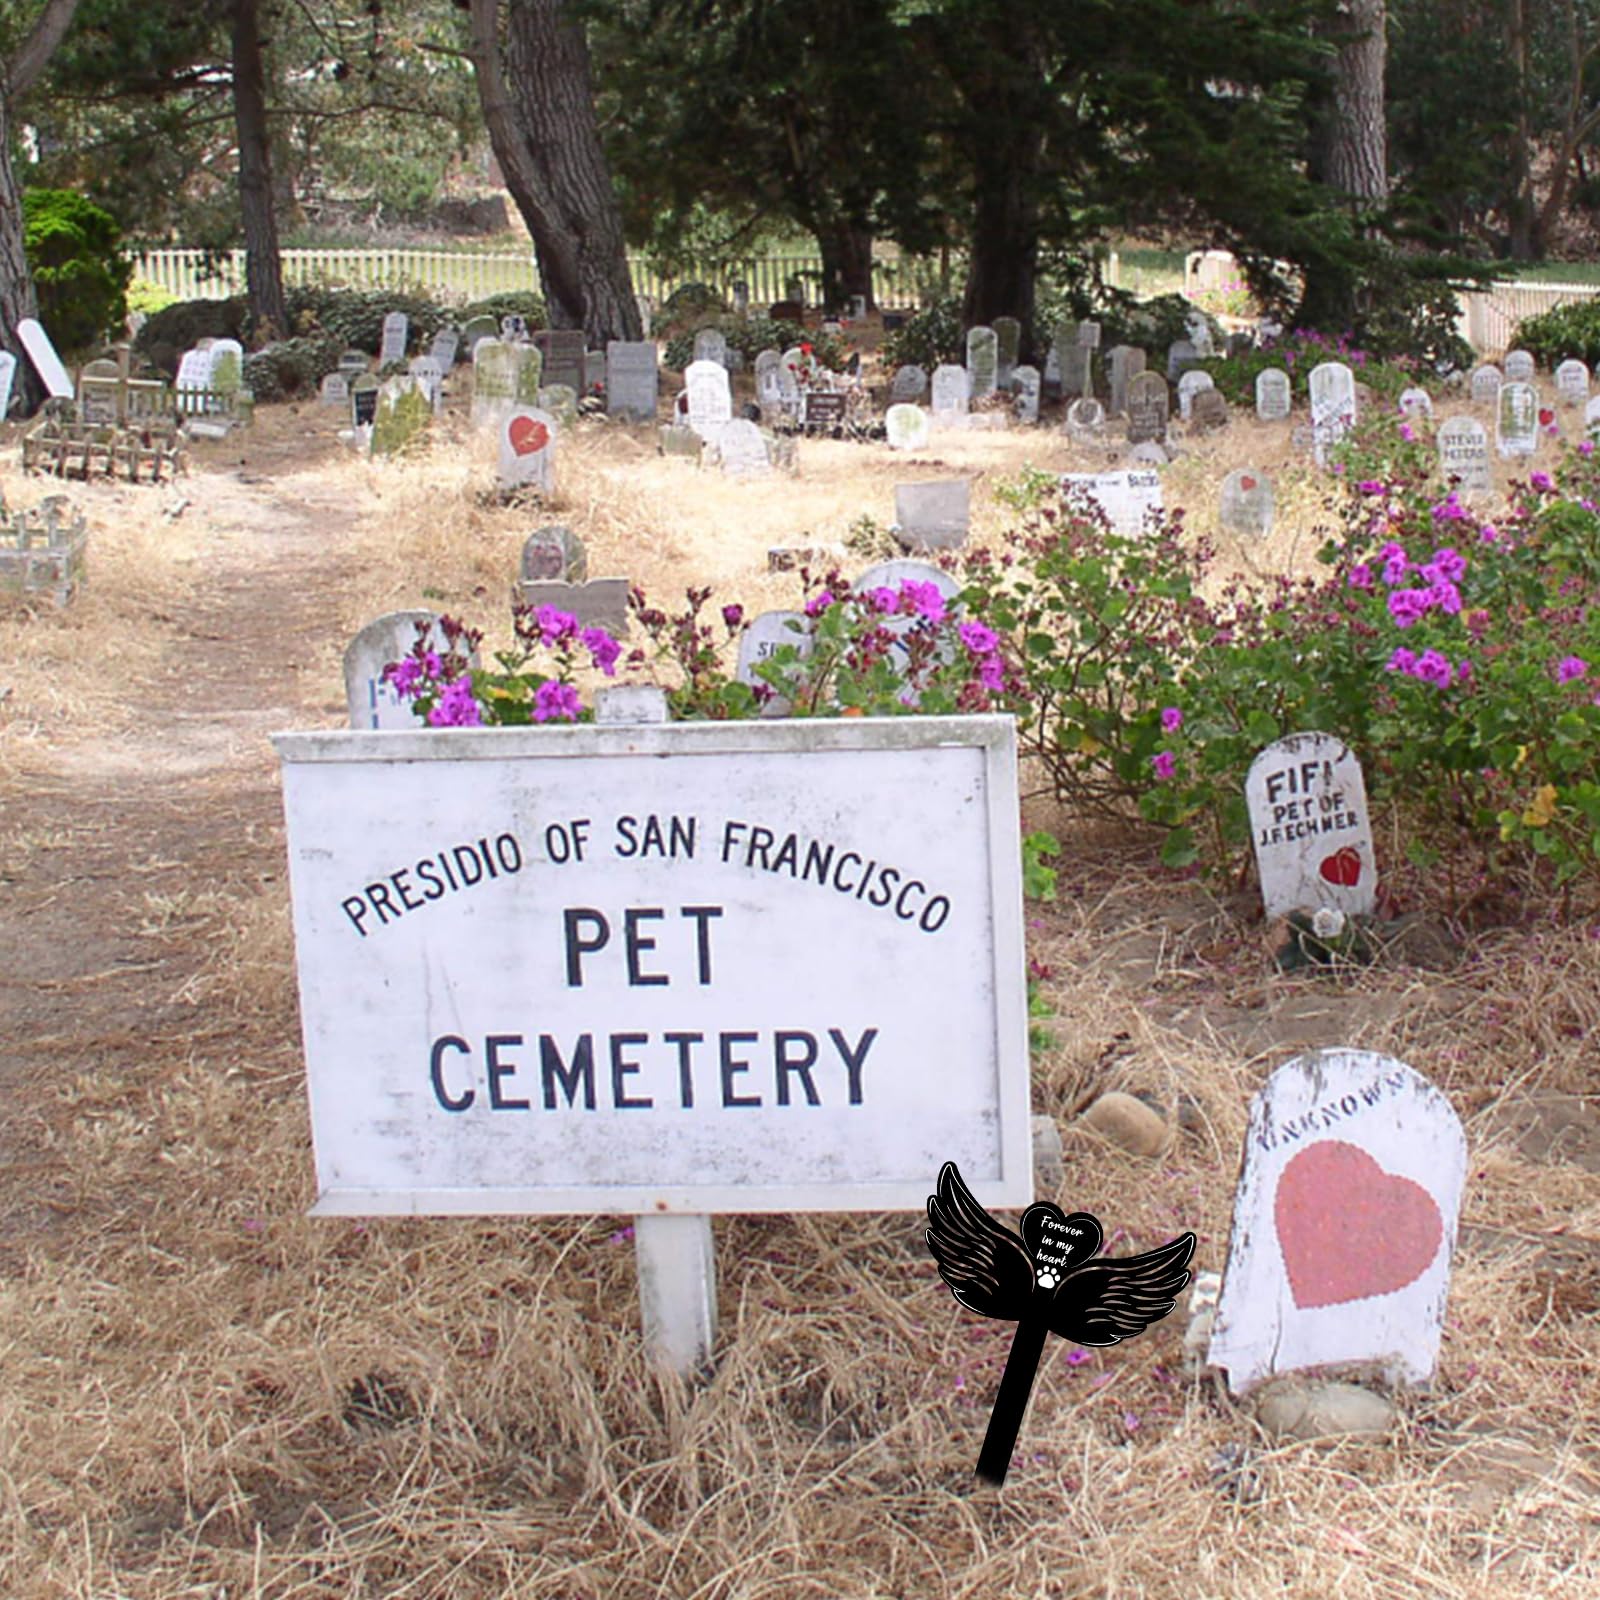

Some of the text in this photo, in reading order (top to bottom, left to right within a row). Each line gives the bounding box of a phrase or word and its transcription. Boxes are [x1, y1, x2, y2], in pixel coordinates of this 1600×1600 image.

[1273, 792, 1345, 824] PET OF
[341, 814, 951, 937] PRESIDIO OF SAN FRANCISCO
[562, 905, 724, 987] PET
[429, 1027, 879, 1112] CEMETERY
[1041, 1215, 1084, 1236] Forever
[1036, 1248, 1068, 1268] heart.
[1041, 1234, 1075, 1255] in my
